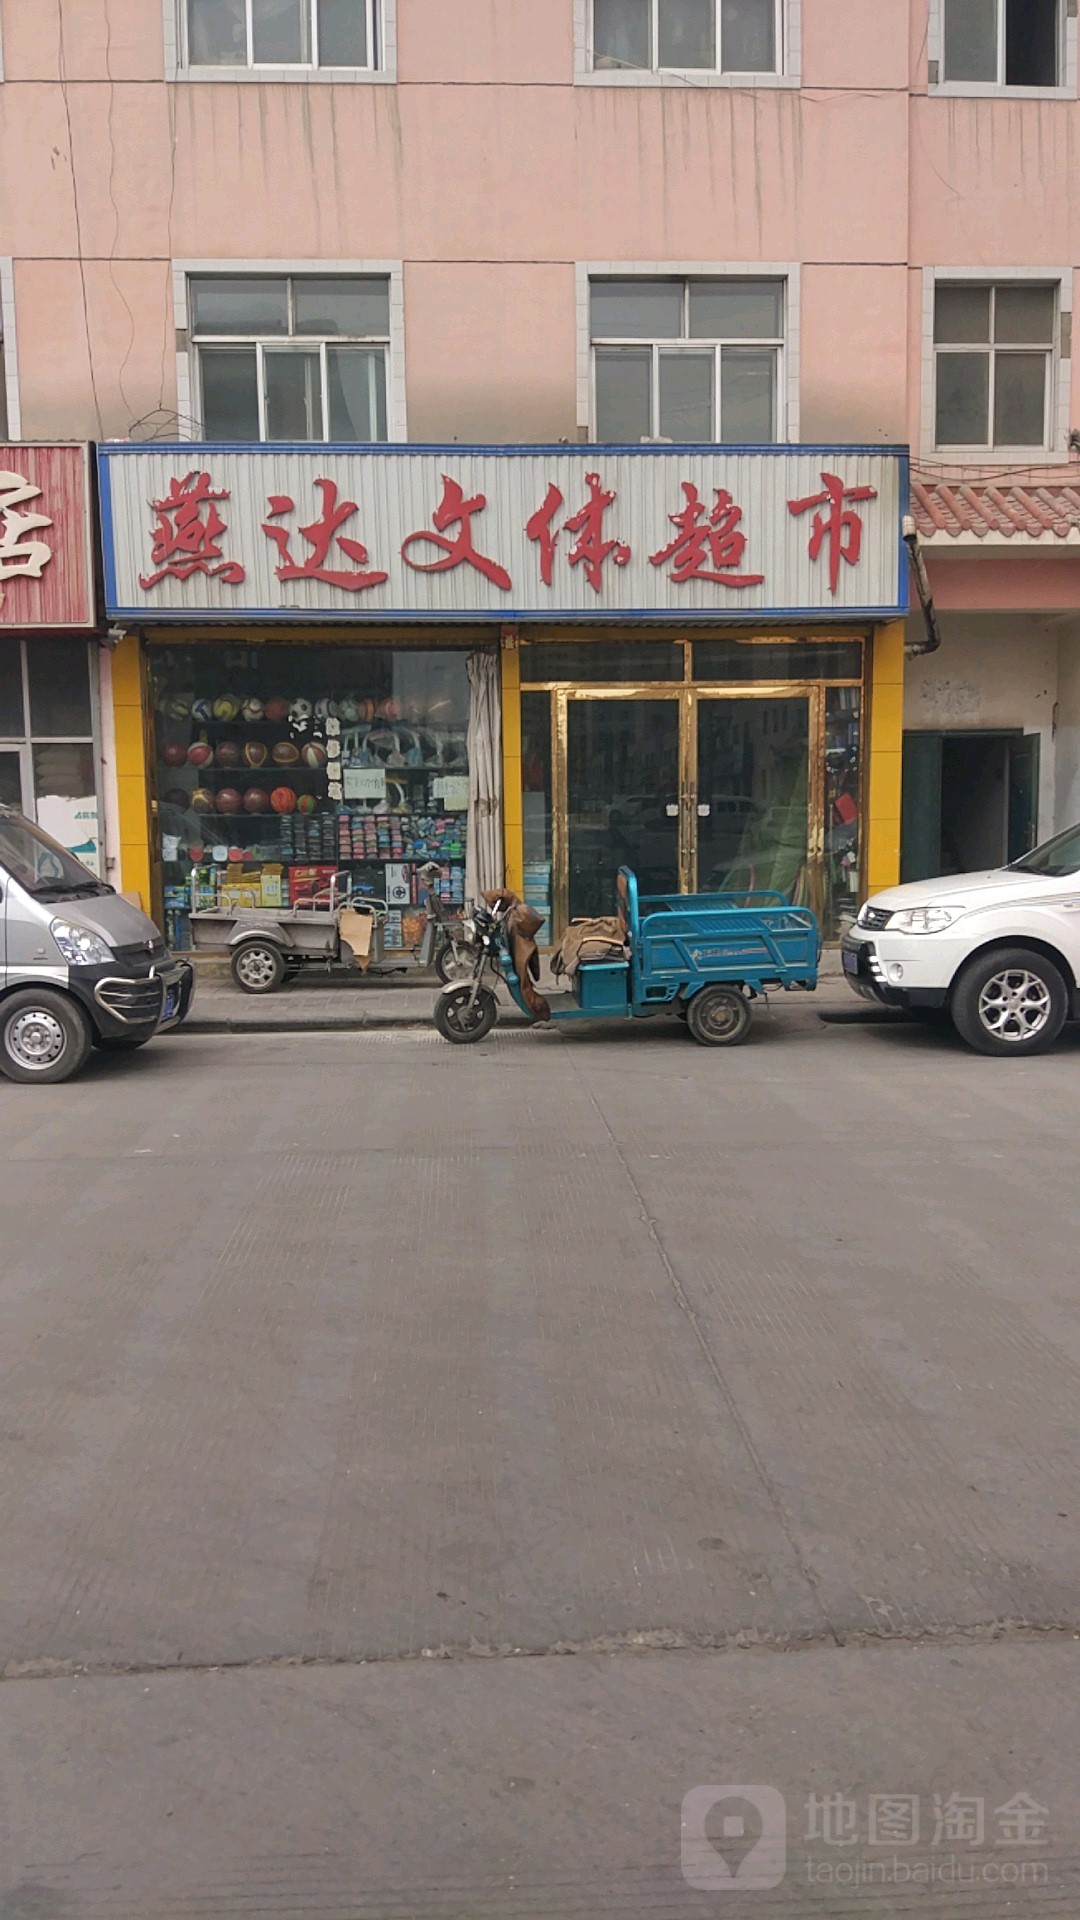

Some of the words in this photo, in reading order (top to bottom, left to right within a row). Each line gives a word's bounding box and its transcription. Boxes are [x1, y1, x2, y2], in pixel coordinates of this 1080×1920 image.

[139, 471, 877, 594] 燕达文体超市
